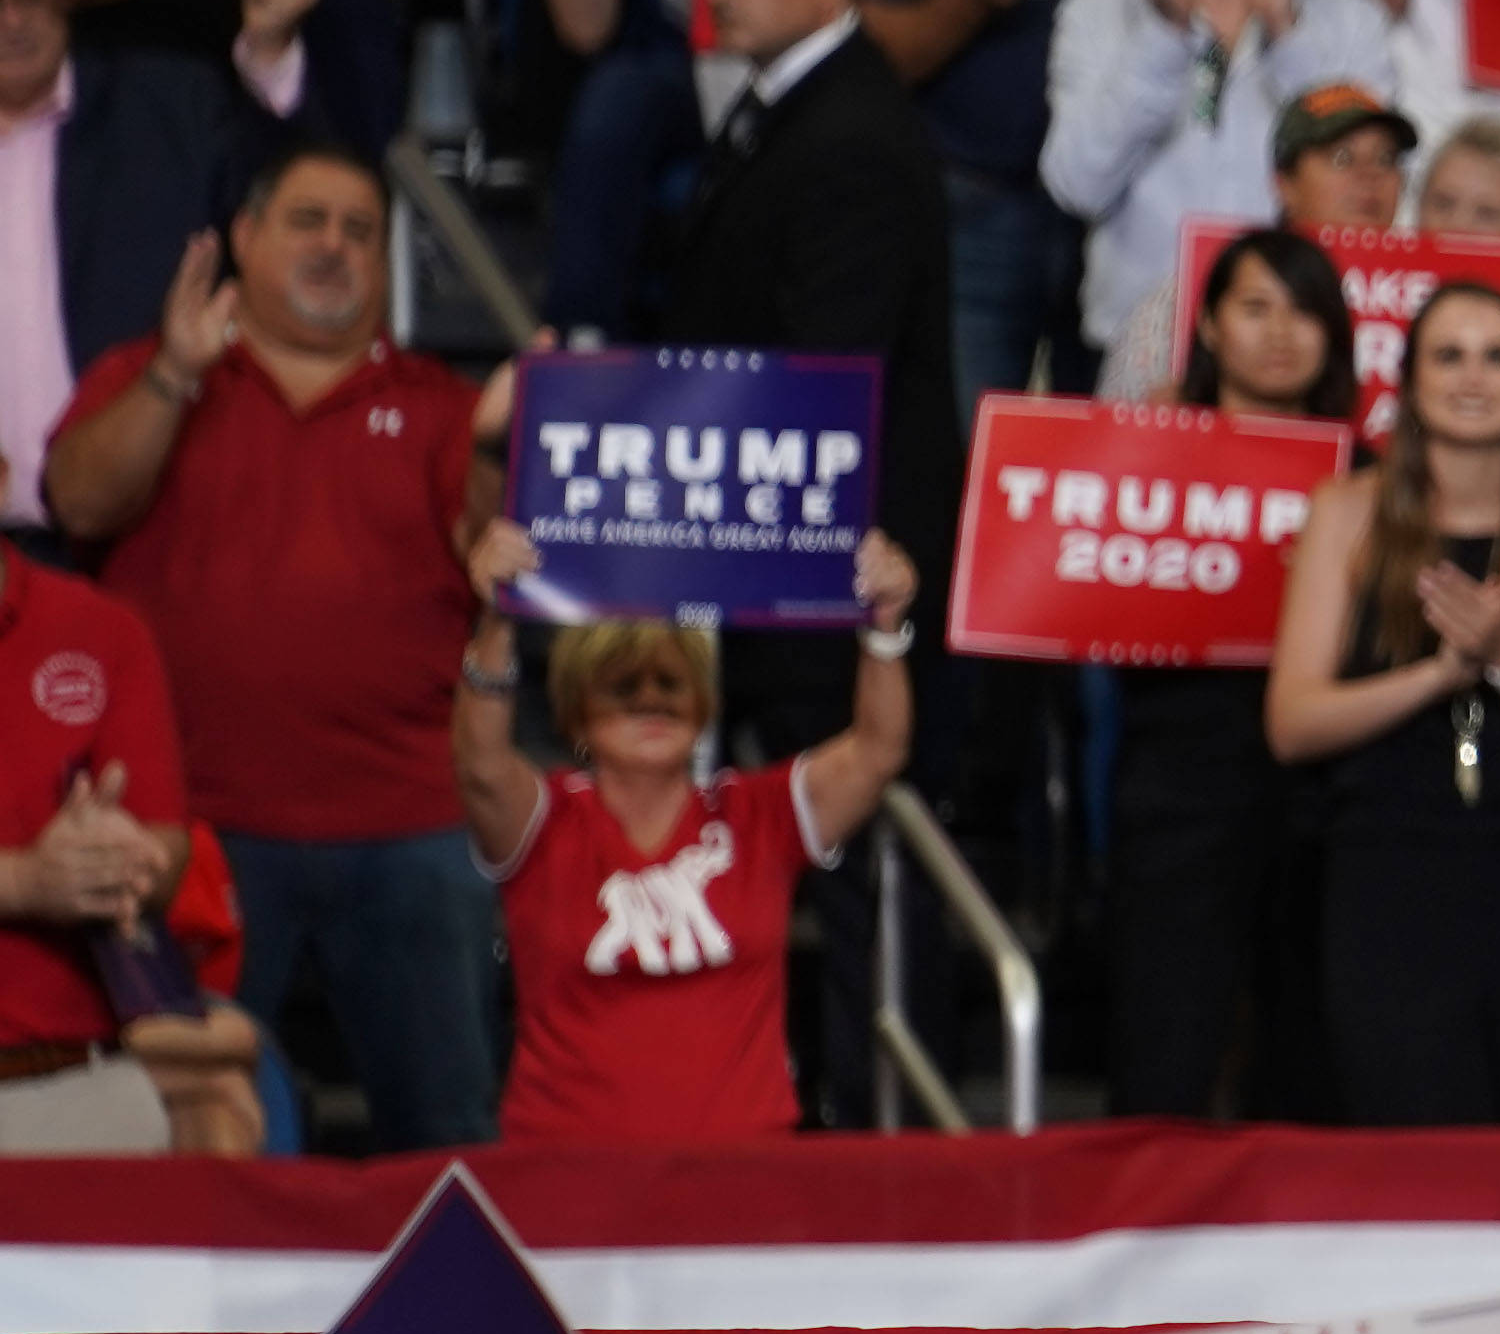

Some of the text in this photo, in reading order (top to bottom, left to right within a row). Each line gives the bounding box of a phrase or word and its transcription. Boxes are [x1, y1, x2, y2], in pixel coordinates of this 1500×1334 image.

[1340, 267, 1440, 317] AKE
[538, 419, 864, 489] TRUMP
[562, 475, 838, 524] PENCE
[997, 466, 1312, 544] TRUMP
[529, 517, 598, 547] MAKE
[599, 518, 705, 550] AMERICA
[1055, 532, 1243, 594] 2020
